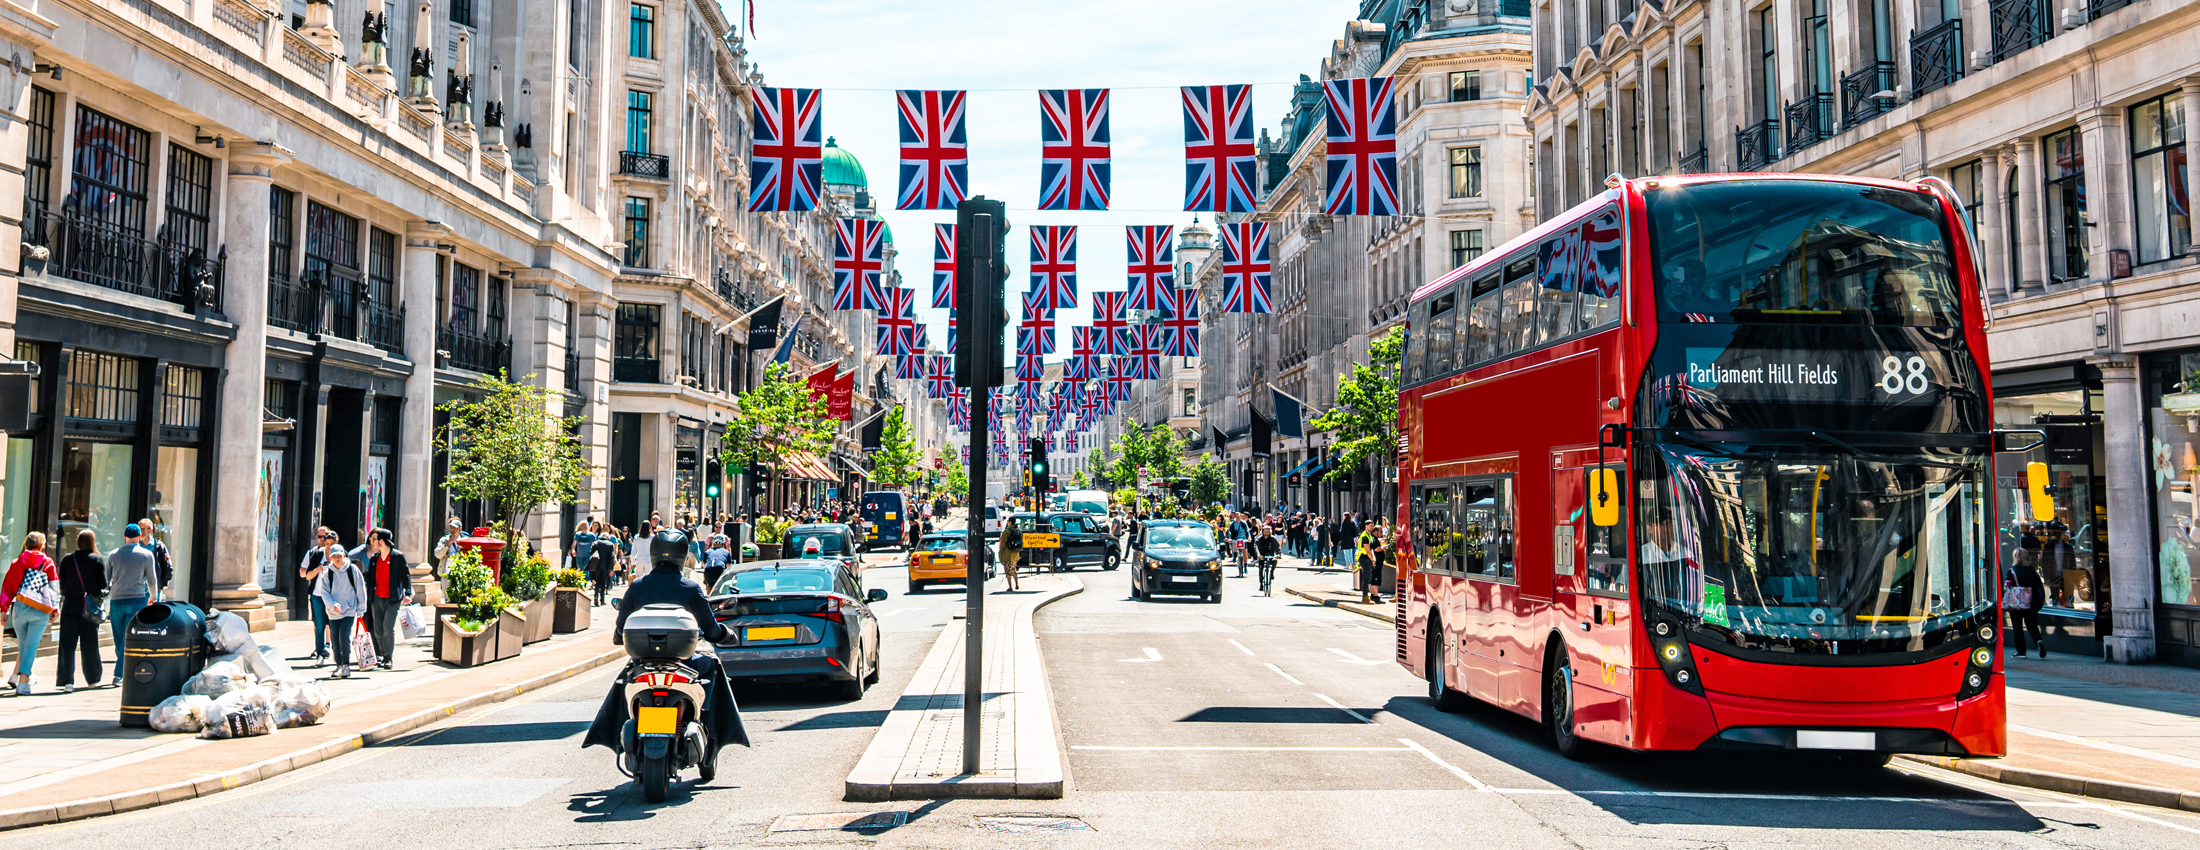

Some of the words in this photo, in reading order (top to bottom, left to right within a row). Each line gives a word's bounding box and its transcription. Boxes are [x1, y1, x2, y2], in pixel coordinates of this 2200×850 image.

[1690, 362, 1764, 384] Parliament
[1768, 363, 1794, 384] Hill
[1798, 363, 1838, 385] Fields
[1881, 355, 1929, 395] 88
